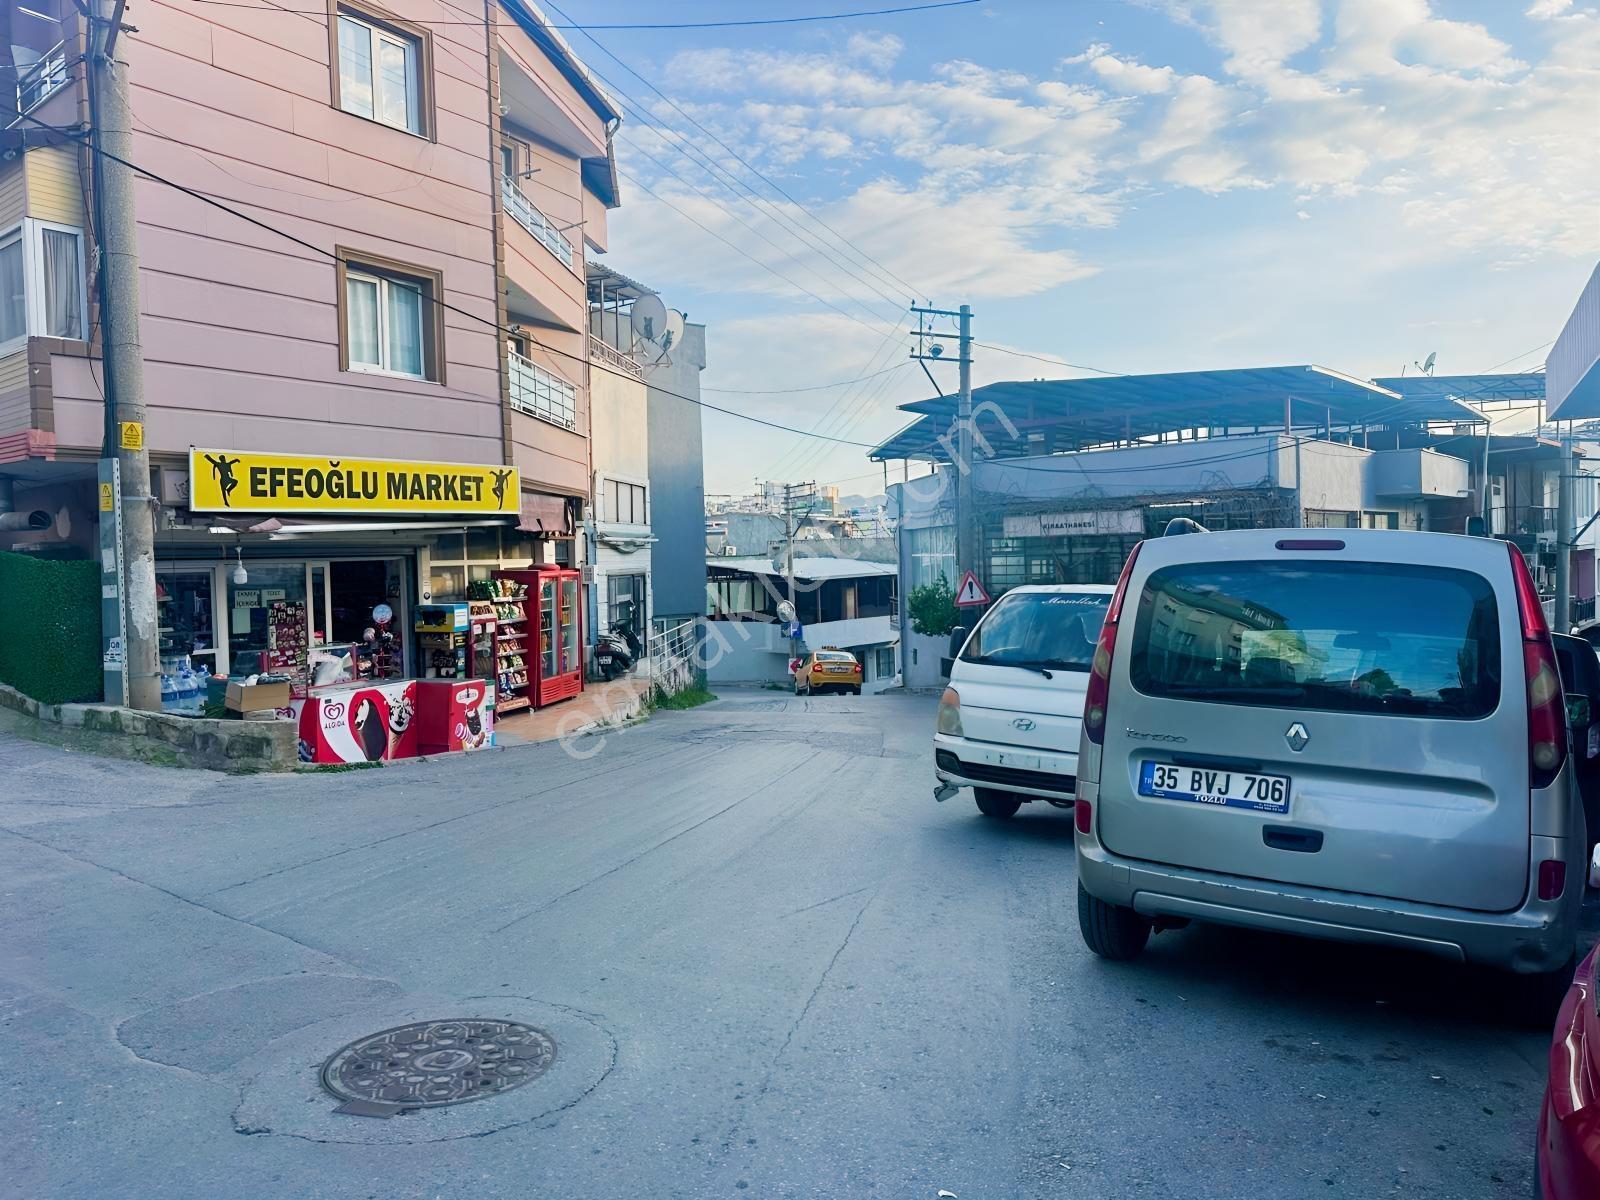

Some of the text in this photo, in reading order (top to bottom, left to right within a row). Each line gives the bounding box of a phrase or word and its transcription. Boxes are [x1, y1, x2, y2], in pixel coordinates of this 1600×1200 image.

[250, 460, 484, 501] EFEOĞLU MARKET
[325, 720, 345, 729] ALGDA
[1154, 766, 1284, 803] 35 BVJ 706
[1194, 794, 1226, 805] TOZLU
